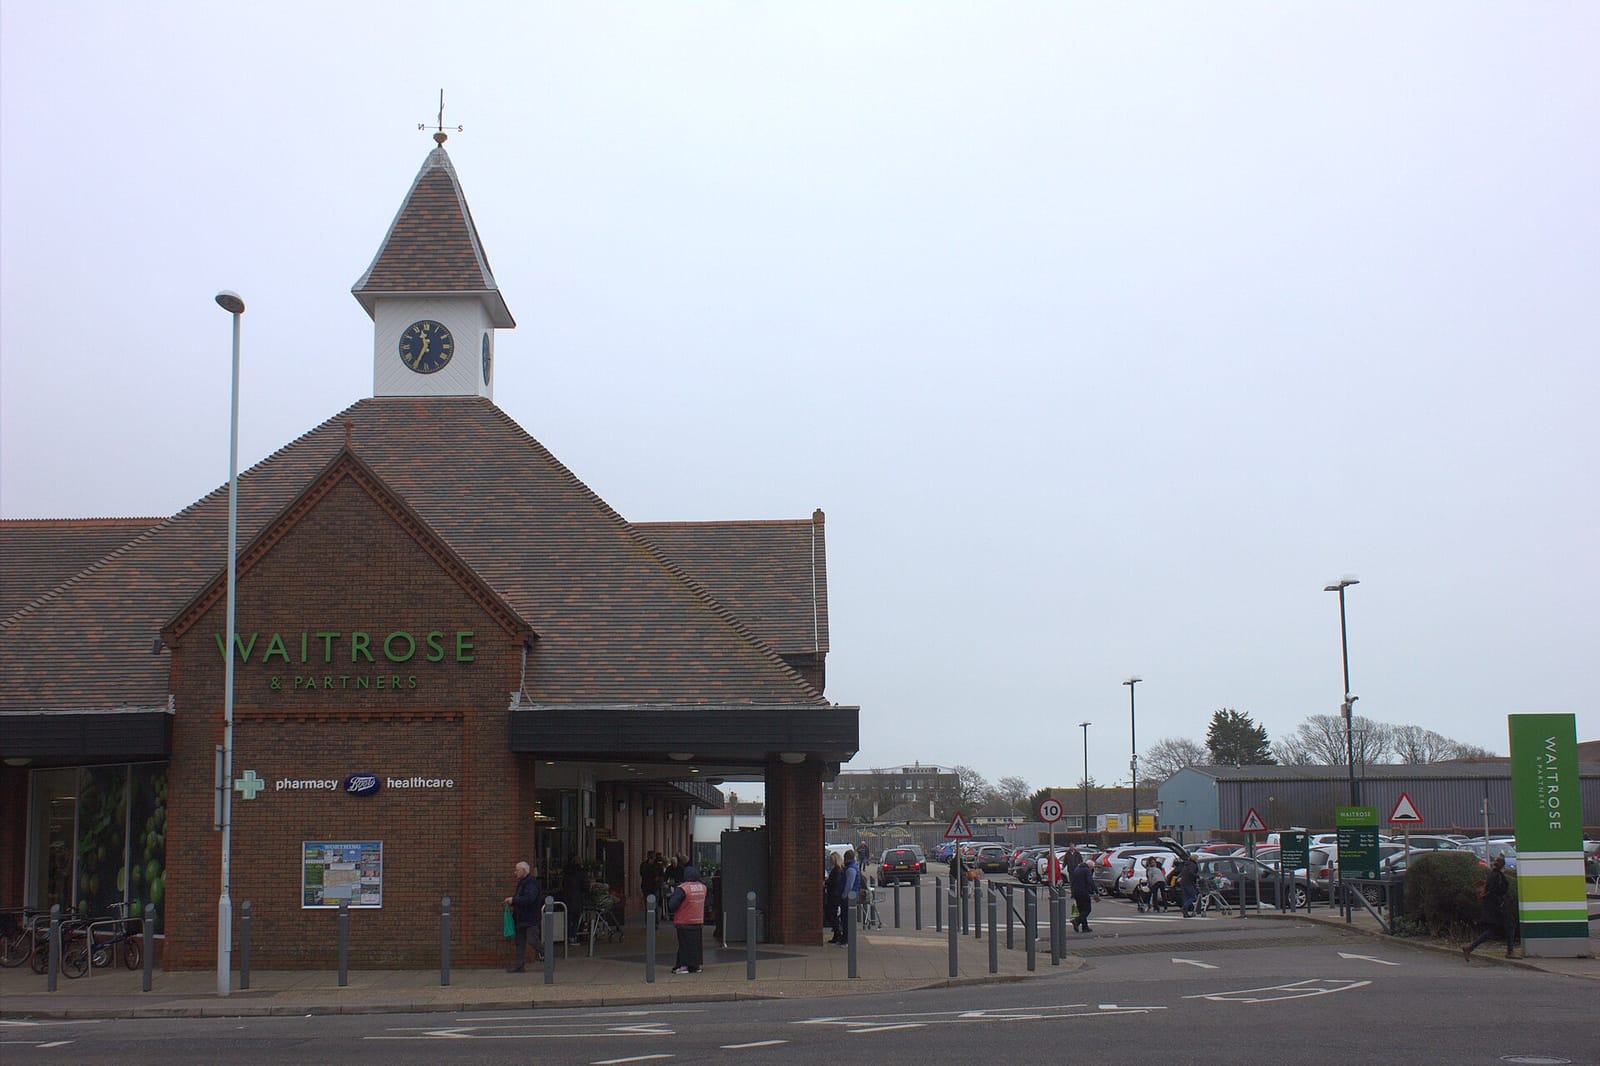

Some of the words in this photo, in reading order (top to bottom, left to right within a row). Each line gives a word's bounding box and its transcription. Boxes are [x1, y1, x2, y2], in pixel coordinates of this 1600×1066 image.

[215, 631, 475, 663] WAITROSE
[270, 676, 281, 690] &
[294, 676, 417, 689] PARTNERS
[276, 778, 338, 790] pharmacy
[347, 776, 376, 791] Boots
[387, 777, 454, 789] healthcare
[1544, 736, 1562, 830] WAITROSE
[1044, 805, 1059, 817] 10
